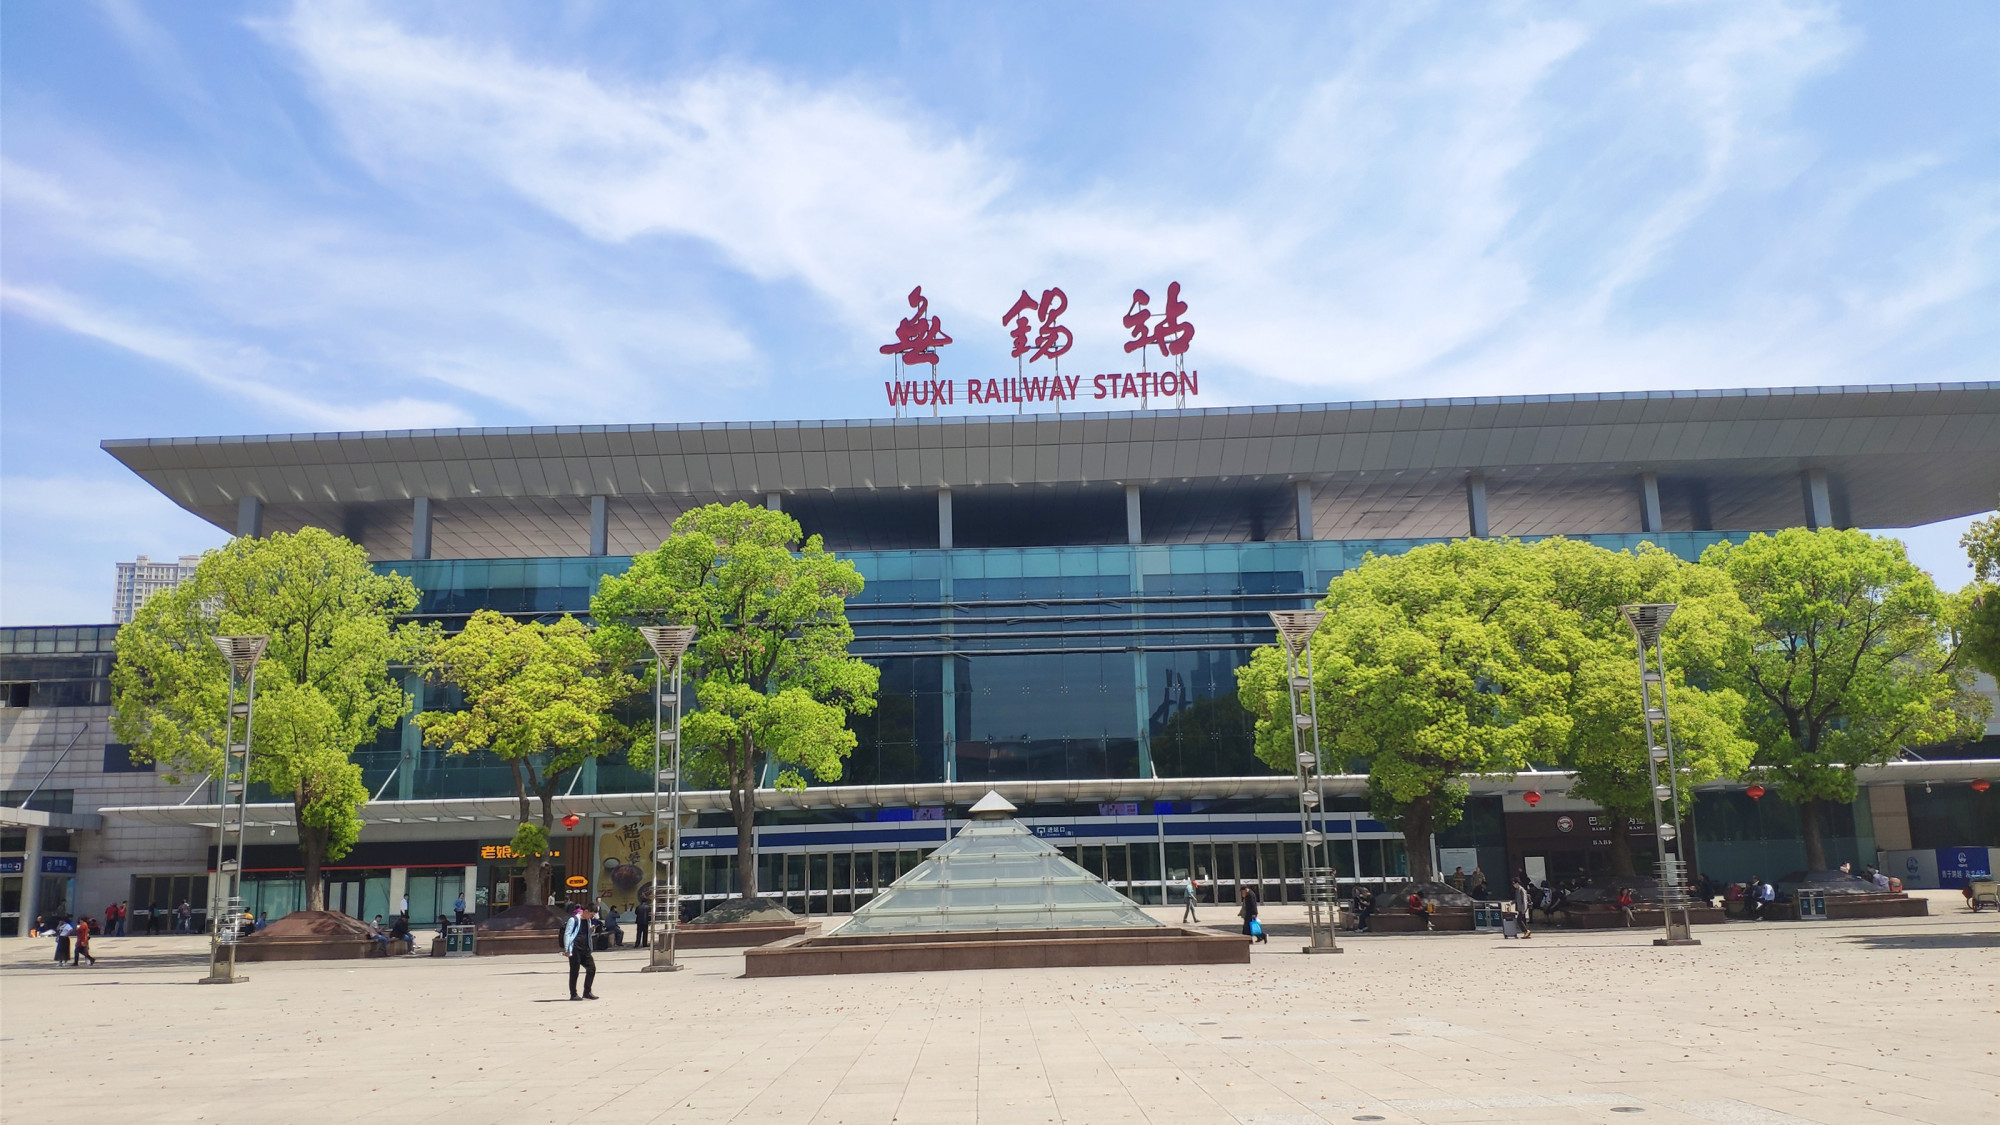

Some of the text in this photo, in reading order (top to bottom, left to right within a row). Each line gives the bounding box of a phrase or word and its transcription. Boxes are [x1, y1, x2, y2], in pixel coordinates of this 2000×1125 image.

[885, 370, 1198, 407] WUXI RAILWAY STATION
